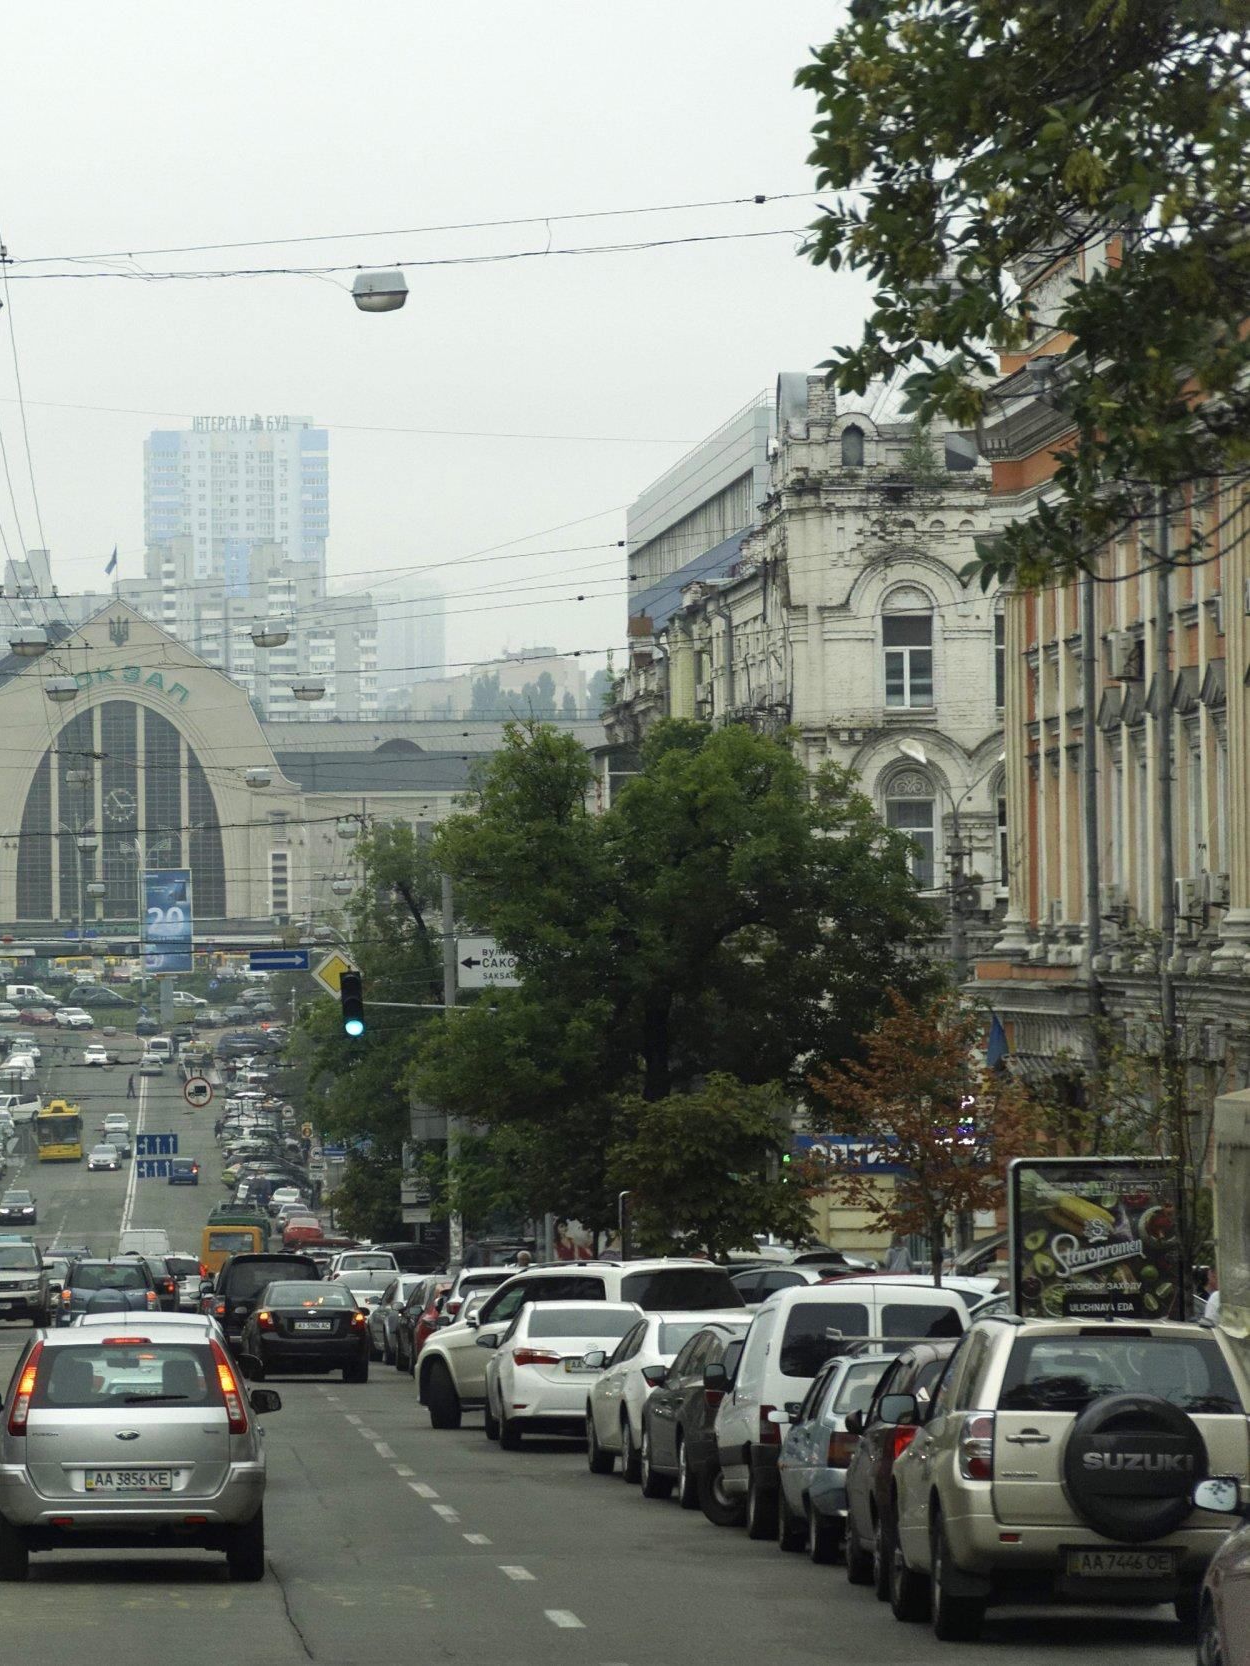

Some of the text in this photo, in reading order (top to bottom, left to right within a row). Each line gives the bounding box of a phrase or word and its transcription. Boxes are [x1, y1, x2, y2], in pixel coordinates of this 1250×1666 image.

[267, 415, 289, 432] БУД
[75, 664, 190, 705] ОКЗАЛ
[148, 907, 184, 935] 20
[482, 958, 516, 968] САКС
[1052, 1234, 1143, 1277] Staropramen
[1117, 1303, 1134, 1311] EDA
[1082, 1452, 1194, 1471] SUZUKI
[95, 1472, 168, 1486] AA 3856 KE
[1081, 1554, 1106, 1571] AA
